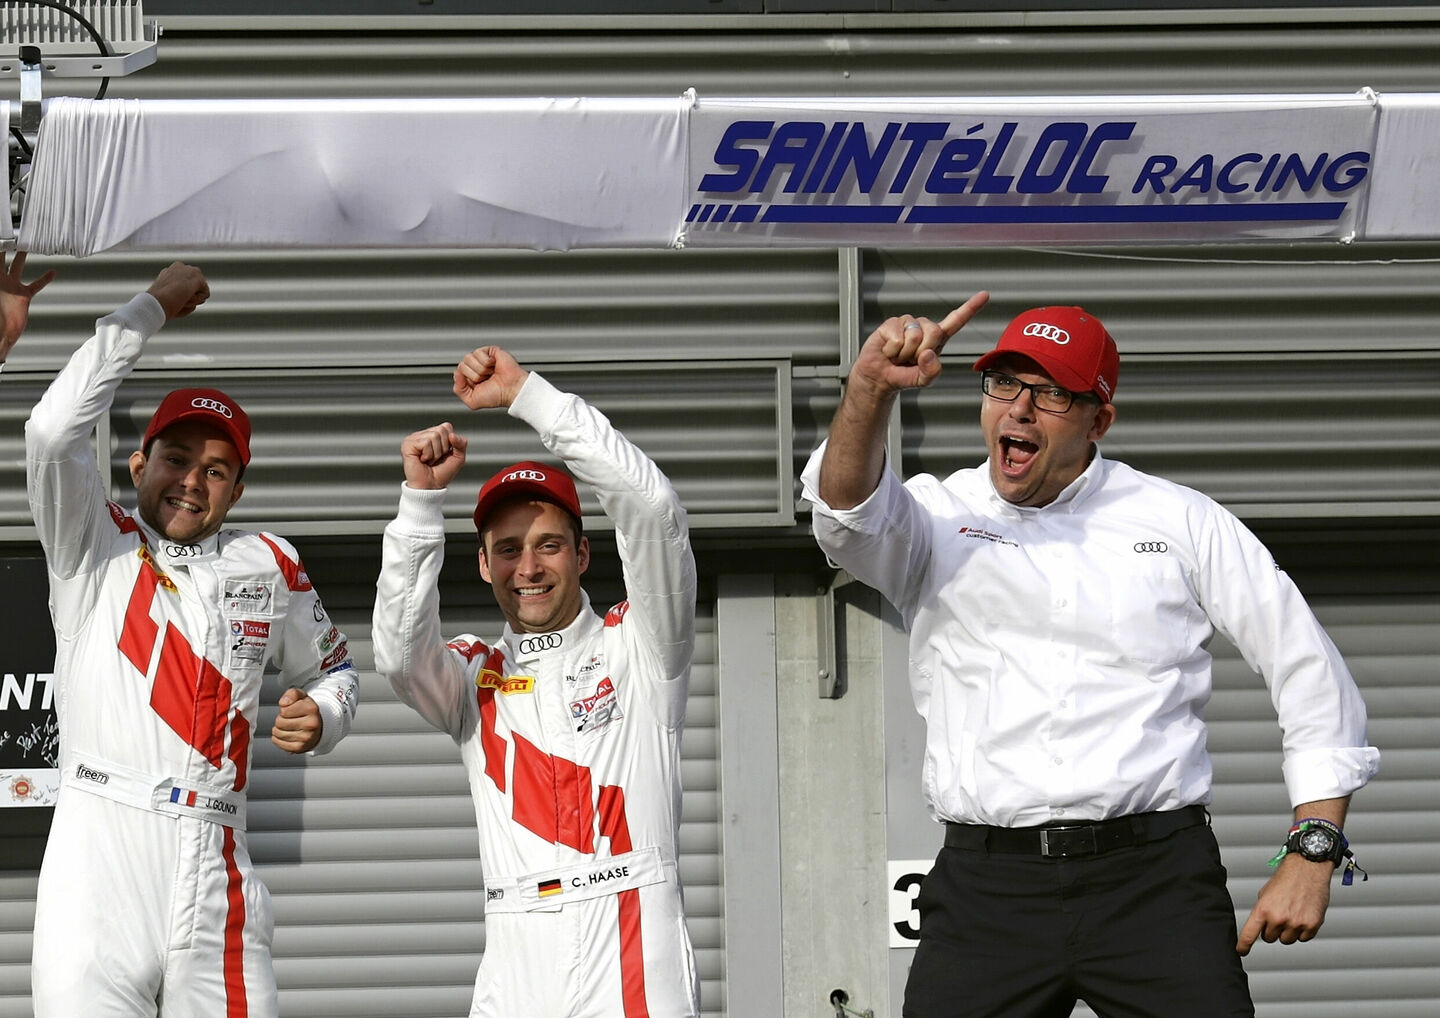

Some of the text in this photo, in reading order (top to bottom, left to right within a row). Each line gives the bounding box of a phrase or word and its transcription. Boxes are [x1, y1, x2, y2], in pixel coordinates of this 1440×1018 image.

[1133, 151, 1370, 194] RACING
[245, 624, 268, 634] TOTAL
[76, 764, 109, 785] freem
[572, 866, 629, 888] C. HAASE
[893, 872, 922, 940] 3
